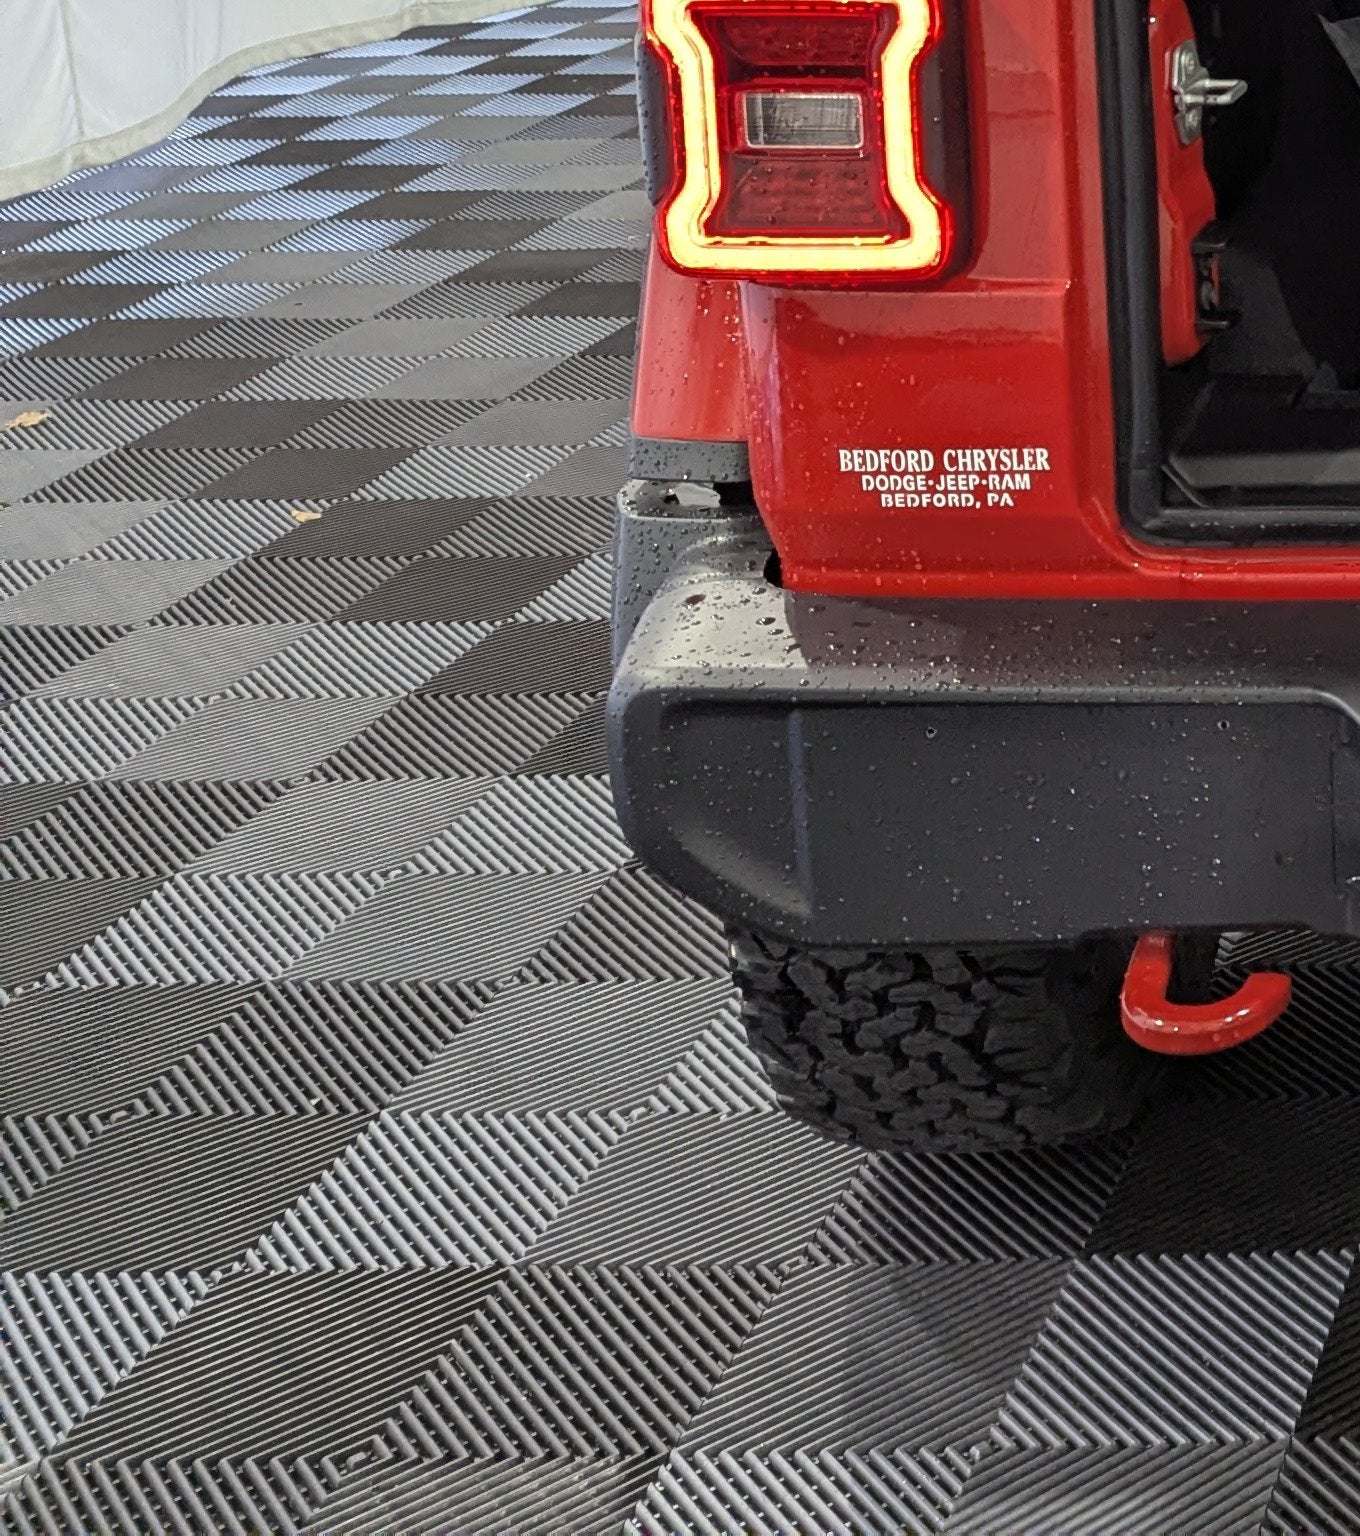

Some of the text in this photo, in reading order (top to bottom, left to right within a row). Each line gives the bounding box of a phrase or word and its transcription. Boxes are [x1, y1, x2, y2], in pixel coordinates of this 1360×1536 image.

[839, 448, 1051, 472] BEDFORD CHRYSLER
[881, 493, 1014, 509] BEDFORD, PA
